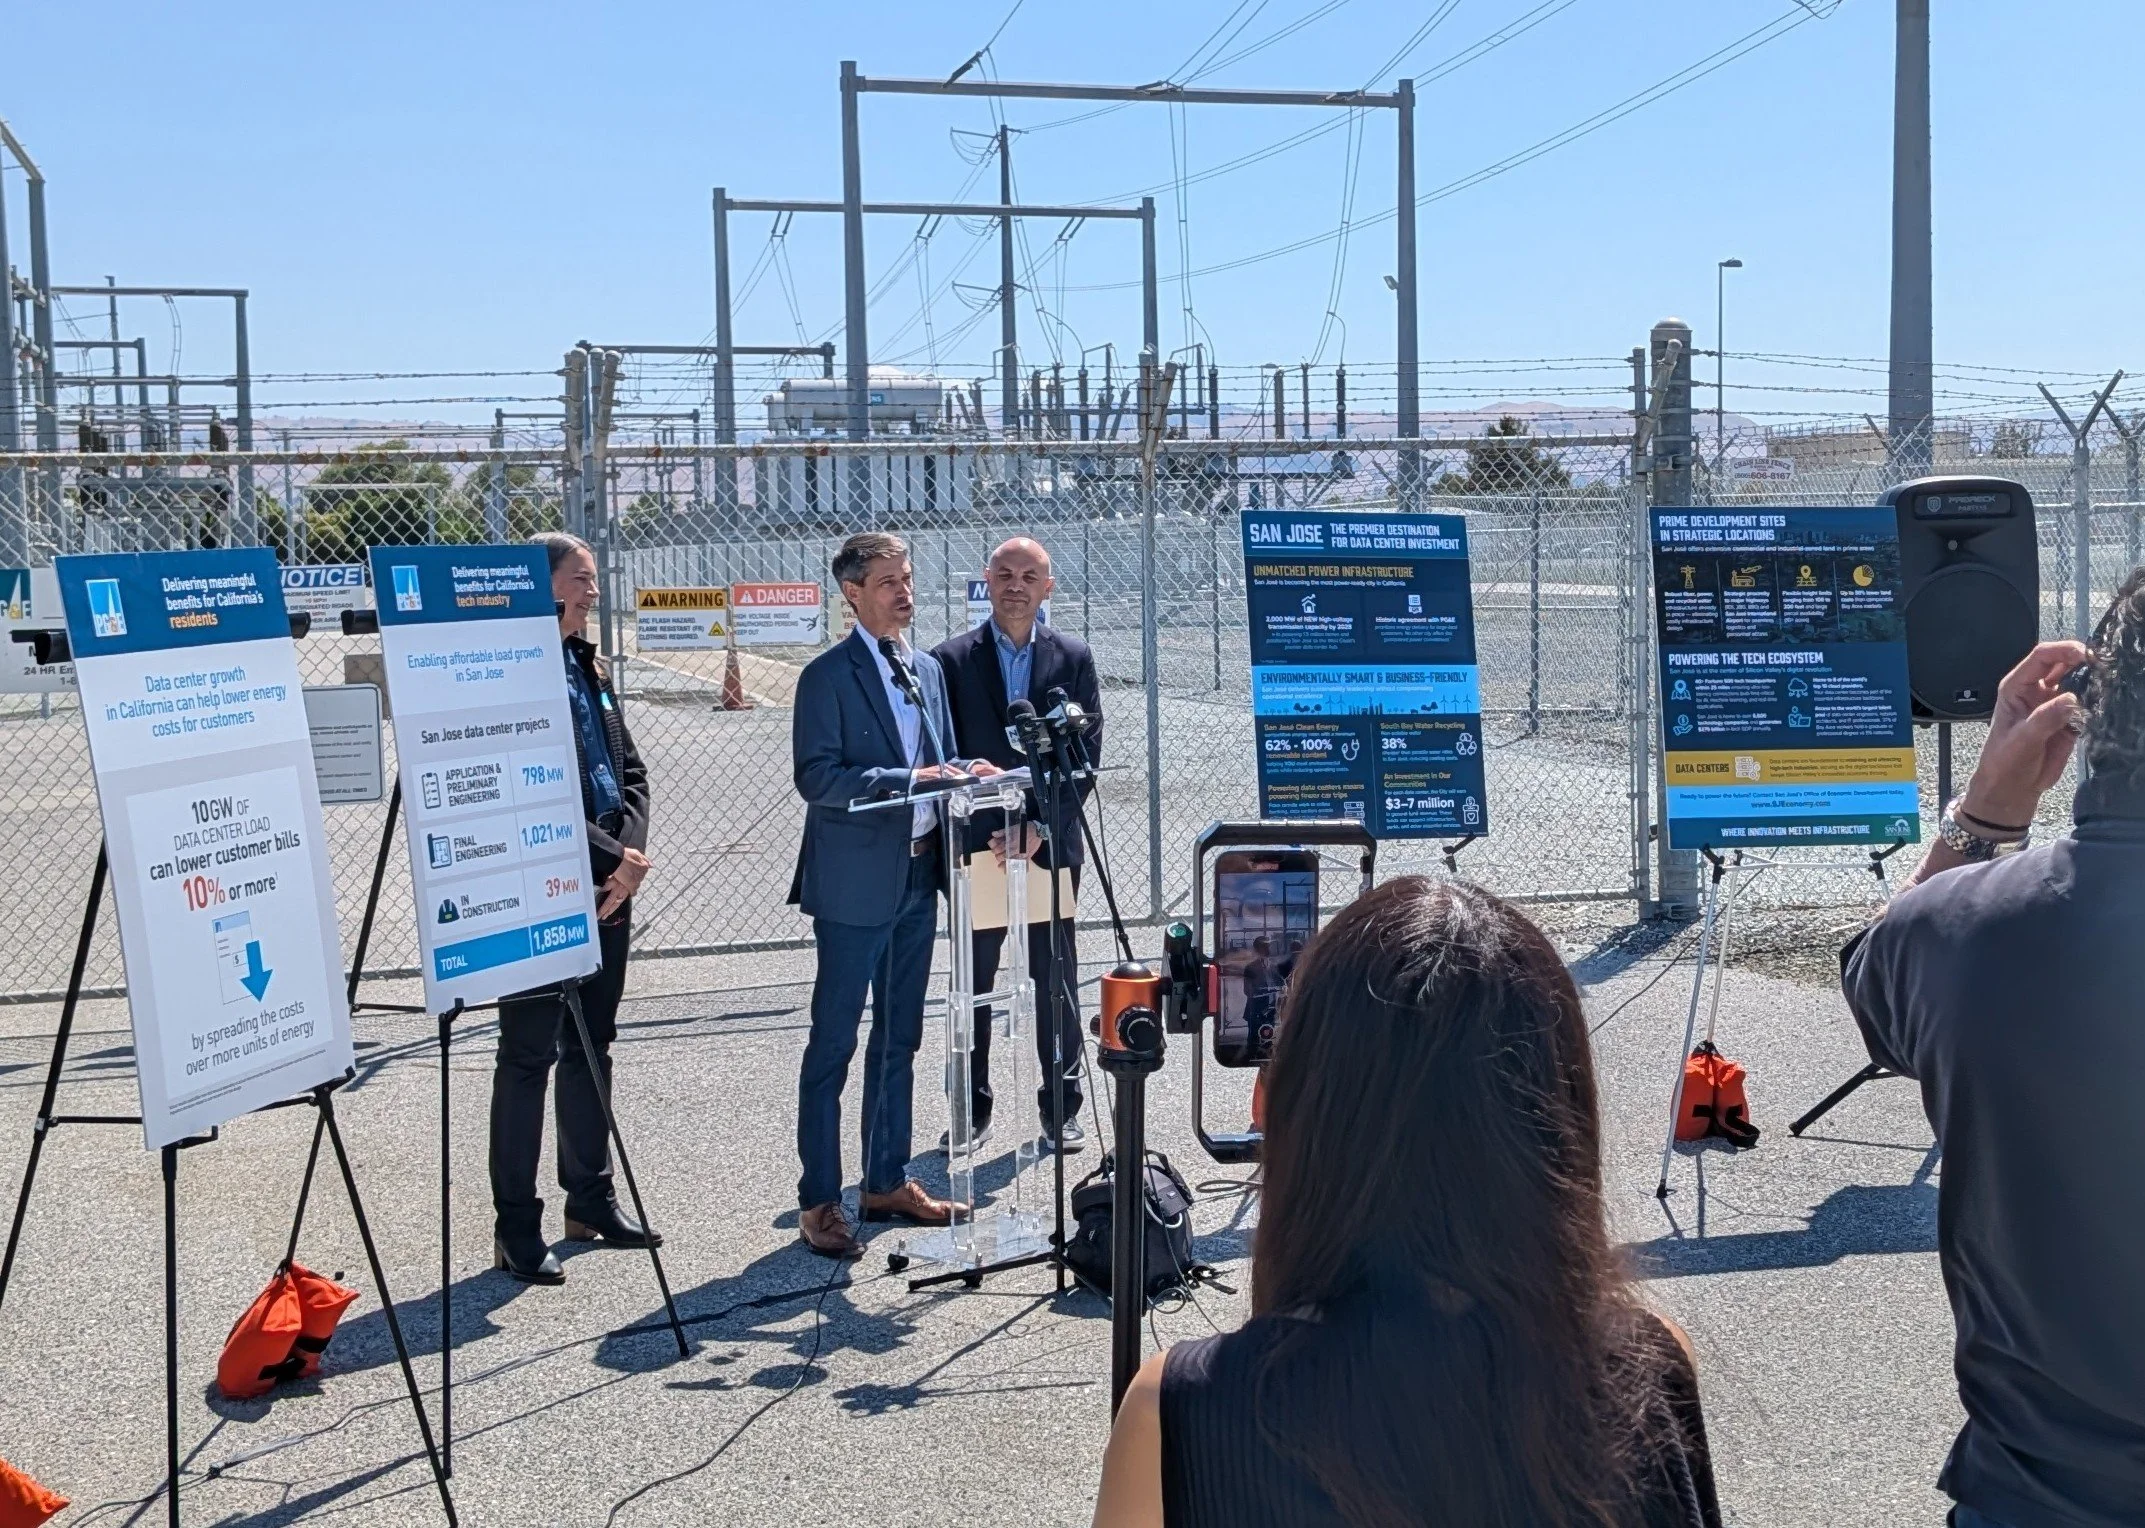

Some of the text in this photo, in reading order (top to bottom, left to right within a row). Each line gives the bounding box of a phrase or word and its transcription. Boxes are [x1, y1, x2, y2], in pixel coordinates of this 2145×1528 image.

[1330, 523, 1440, 536] THE PREMIER DESTINATION
[1659, 515, 1786, 527] PRIME DEVELOPMENT SITES
[1249, 523, 1324, 543] SAN JOSE
[1660, 529, 1775, 541] IN STRATEGIC LOCATIONS
[1331, 536, 1459, 550] FOR DATA CENTER INVESTMENT
[452, 565, 530, 580] Delivering meaningful
[1253, 565, 1414, 578] UNMATCHED POWER INFRASTRUCTURE
[161, 573, 257, 592] Delivering meaningful
[454, 579, 535, 593] benefits for California's
[165, 590, 264, 611] benefits for California's
[456, 594, 510, 608] tech industry
[658, 592, 723, 607] WARNING
[757, 588, 814, 604] DANGER
[0, 600, 32, 619] G&E
[170, 612, 218, 629] residents
[408, 646, 544, 669] Enabling affordable load growth
[1668, 652, 1824, 665] POWERING THE TECH ECOSYSTEM
[24, 667, 37, 676] 24
[40, 666, 55, 675] HR
[145, 666, 246, 692] Data center growth
[455, 667, 504, 682] in San Jose
[1261, 672, 1342, 684] ENVIRONMENTALLY
[1344, 672, 1374, 683] SMART
[1377, 672, 1383, 683] &
[105, 684, 287, 721] in California can help lower energy
[152, 710, 255, 737] costs for customers
[421, 717, 550, 744] San Jose data center projects
[1316, 723, 1340, 731] Energy
[1265, 739, 1291, 751] 62%
[1301, 739, 1333, 750] 100%
[1381, 738, 1407, 749] 38%
[445, 763, 564, 786] APPLICATION & 798 MW
[1676, 763, 1729, 773] DATA CENTERS
[447, 776, 498, 794] PRELIMINARY
[448, 789, 501, 807] ENGINEERING
[1418, 797, 1455, 809] million
[236, 799, 250, 816] OF
[174, 816, 271, 851] DATA CENTER LOAD
[453, 823, 573, 849] FINAL 1,021 MW
[1721, 825, 1870, 837] WHERE INNOVATION MEETS INFRASTRUCTURE
[150, 830, 300, 880] can lower customer bills
[455, 842, 507, 862] ENGINEERING
[183, 875, 226, 911] 10%
[229, 884, 242, 900] or
[461, 877, 579, 906] IN 39 MW
[462, 896, 520, 920] CONSTRUCTION
[533, 925, 585, 952] 1,858 MW
[440, 955, 468, 972] TOTAL
[192, 1000, 305, 1052] by spreading the costs
[186, 1020, 315, 1076] over more units of energy
